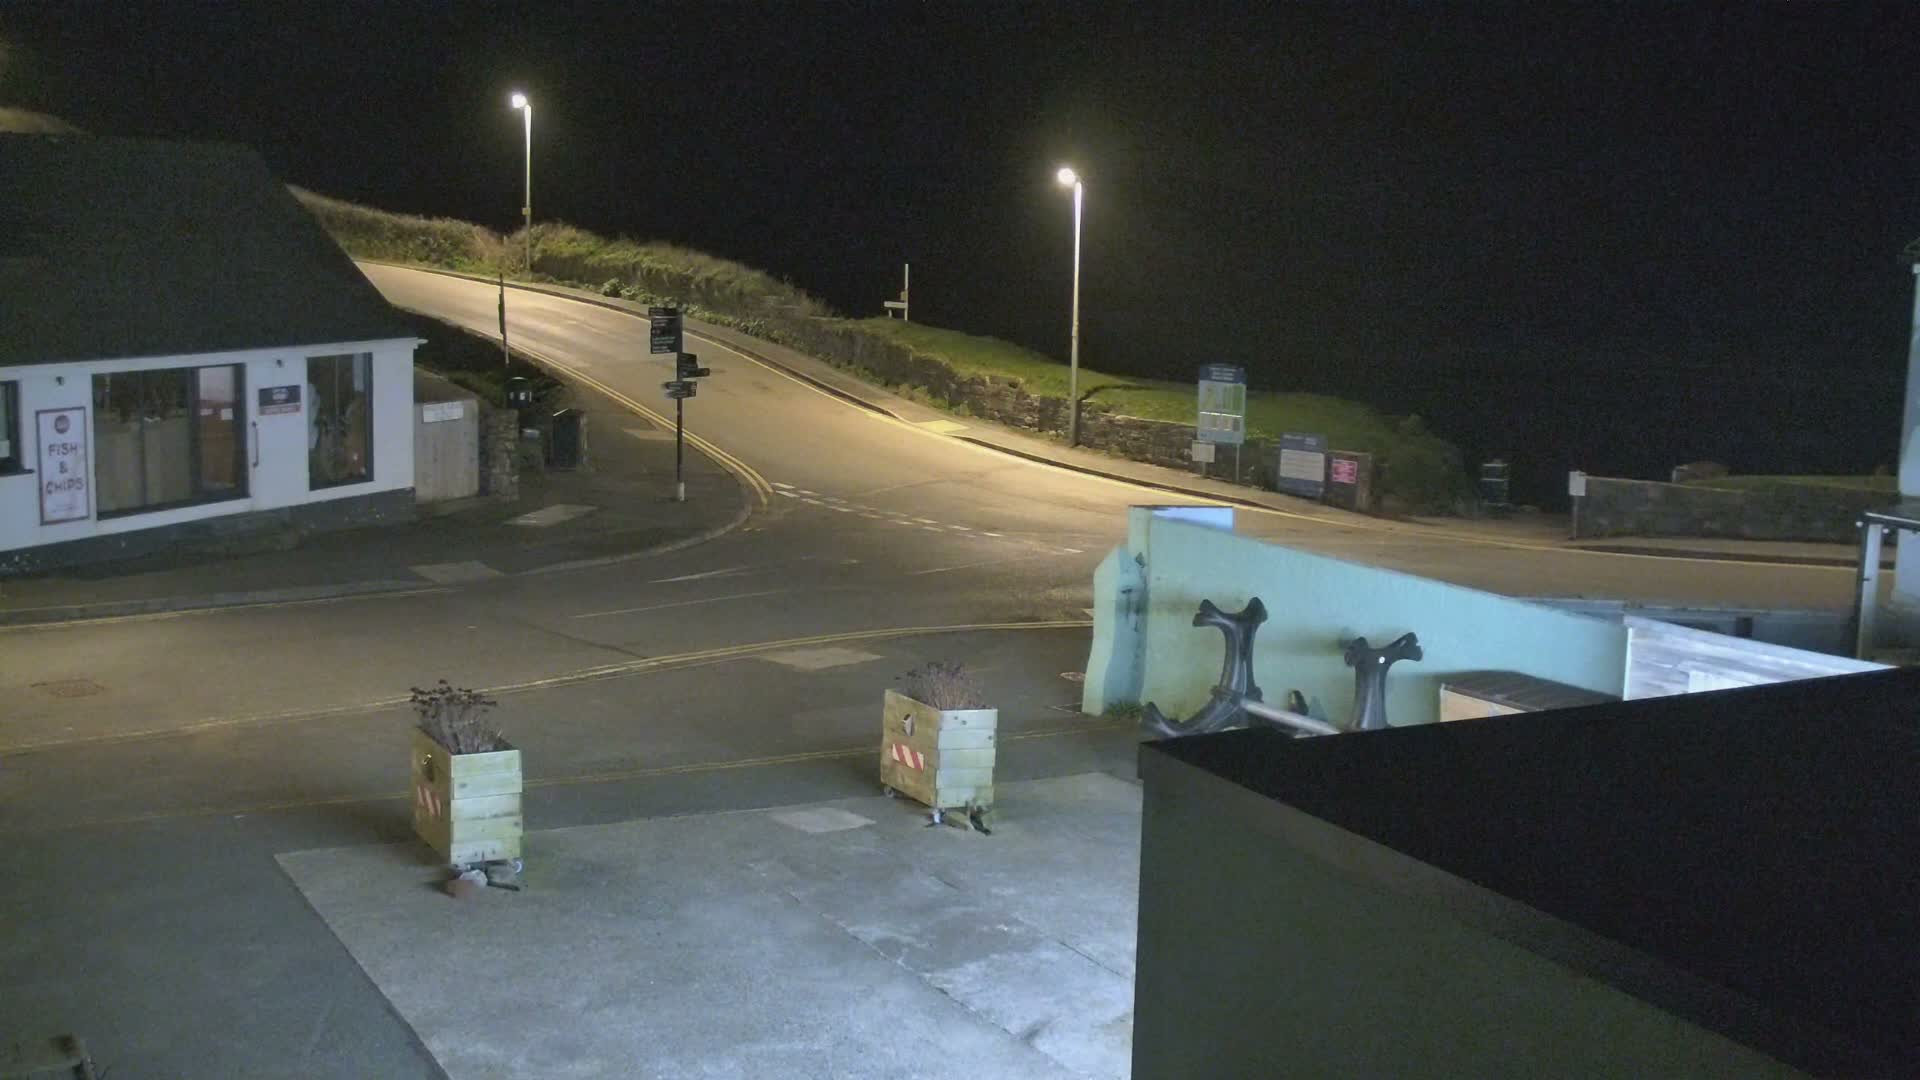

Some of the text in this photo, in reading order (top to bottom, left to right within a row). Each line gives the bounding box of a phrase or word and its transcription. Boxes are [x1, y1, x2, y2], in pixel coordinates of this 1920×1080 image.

[48, 443, 78, 457] FISH
[59, 460, 69, 474] &
[46, 478, 84, 495] CHIPS
